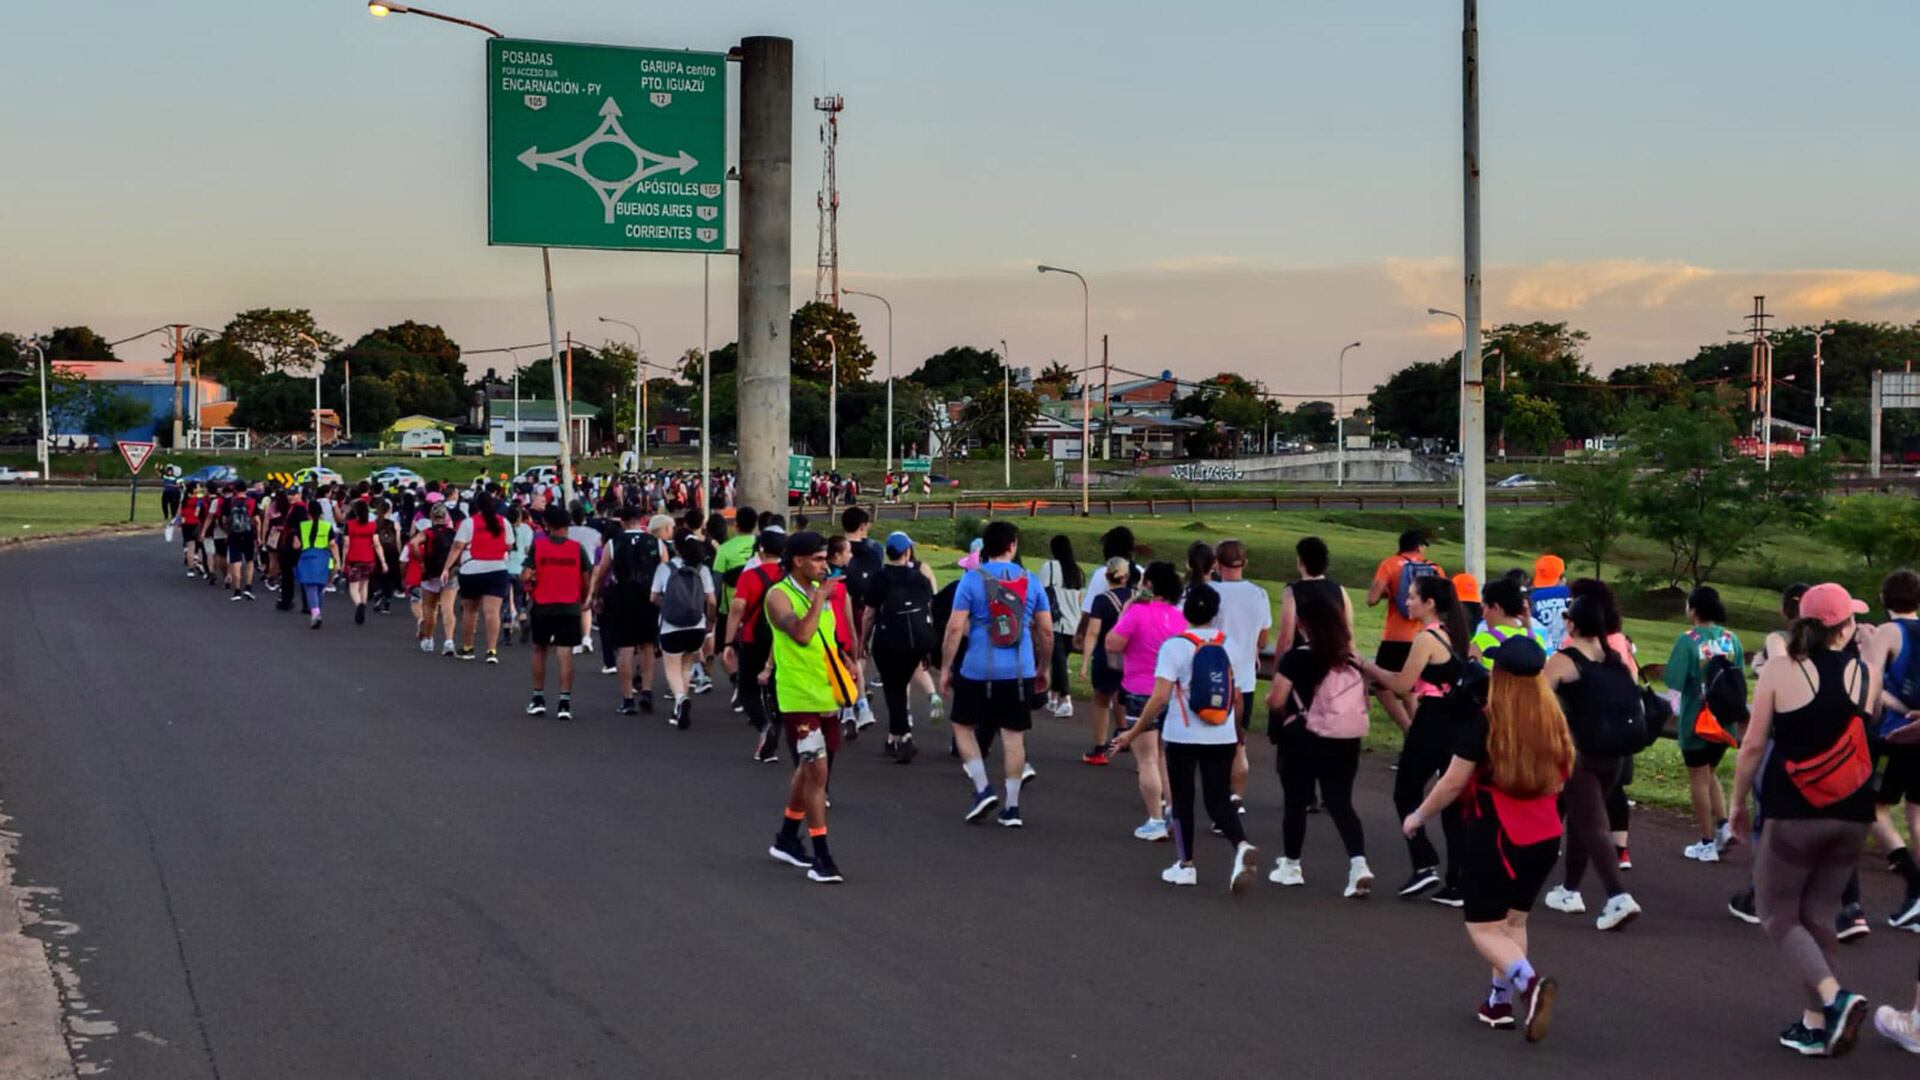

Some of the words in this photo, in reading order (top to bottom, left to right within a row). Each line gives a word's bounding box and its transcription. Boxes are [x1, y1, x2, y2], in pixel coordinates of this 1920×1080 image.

[502, 50, 553, 66] POSADAS
[640, 59, 684, 74] GARUPA
[686, 65, 716, 76] centro
[502, 78, 579, 94] ENCARNACIÓN
[587, 83, 602, 95] PY
[641, 76, 665, 90] PTO.
[667, 76, 704, 92] IGUAZÚ
[528, 96, 543, 107] 105
[656, 94, 666, 104] 12
[637, 178, 699, 195] APÓSTOLES
[704, 185, 717, 195] 105
[616, 202, 659, 216] BUENOS
[661, 204, 693, 218] AIRES
[703, 208, 713, 217] 14
[625, 224, 692, 239] CORRIENTES
[703, 230, 713, 240] 12
